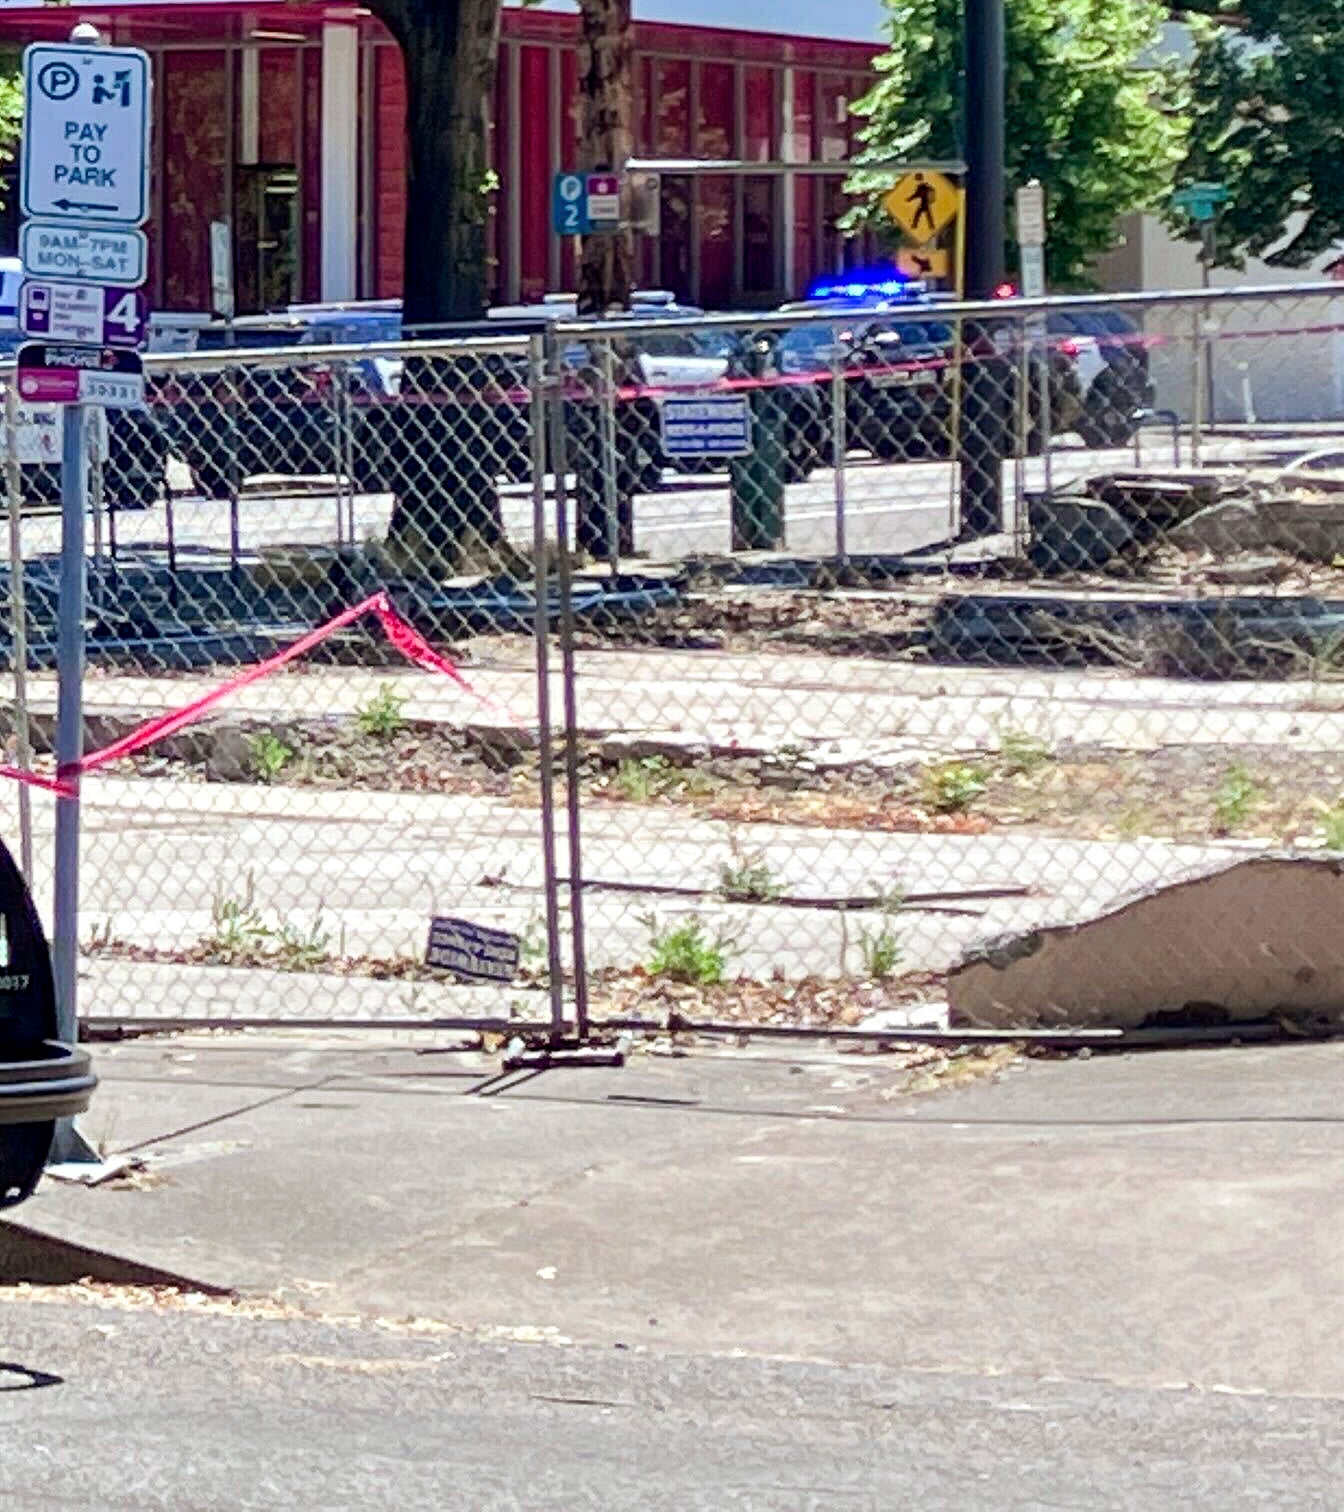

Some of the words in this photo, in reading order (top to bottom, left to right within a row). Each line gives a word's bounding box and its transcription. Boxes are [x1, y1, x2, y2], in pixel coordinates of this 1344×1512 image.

[63, 120, 108, 142] PAY
[70, 144, 101, 164] TO
[54, 164, 116, 188] PARK
[564, 204, 579, 227] 2
[37, 251, 129, 273] MON-SAT
[106, 292, 142, 333] 4
